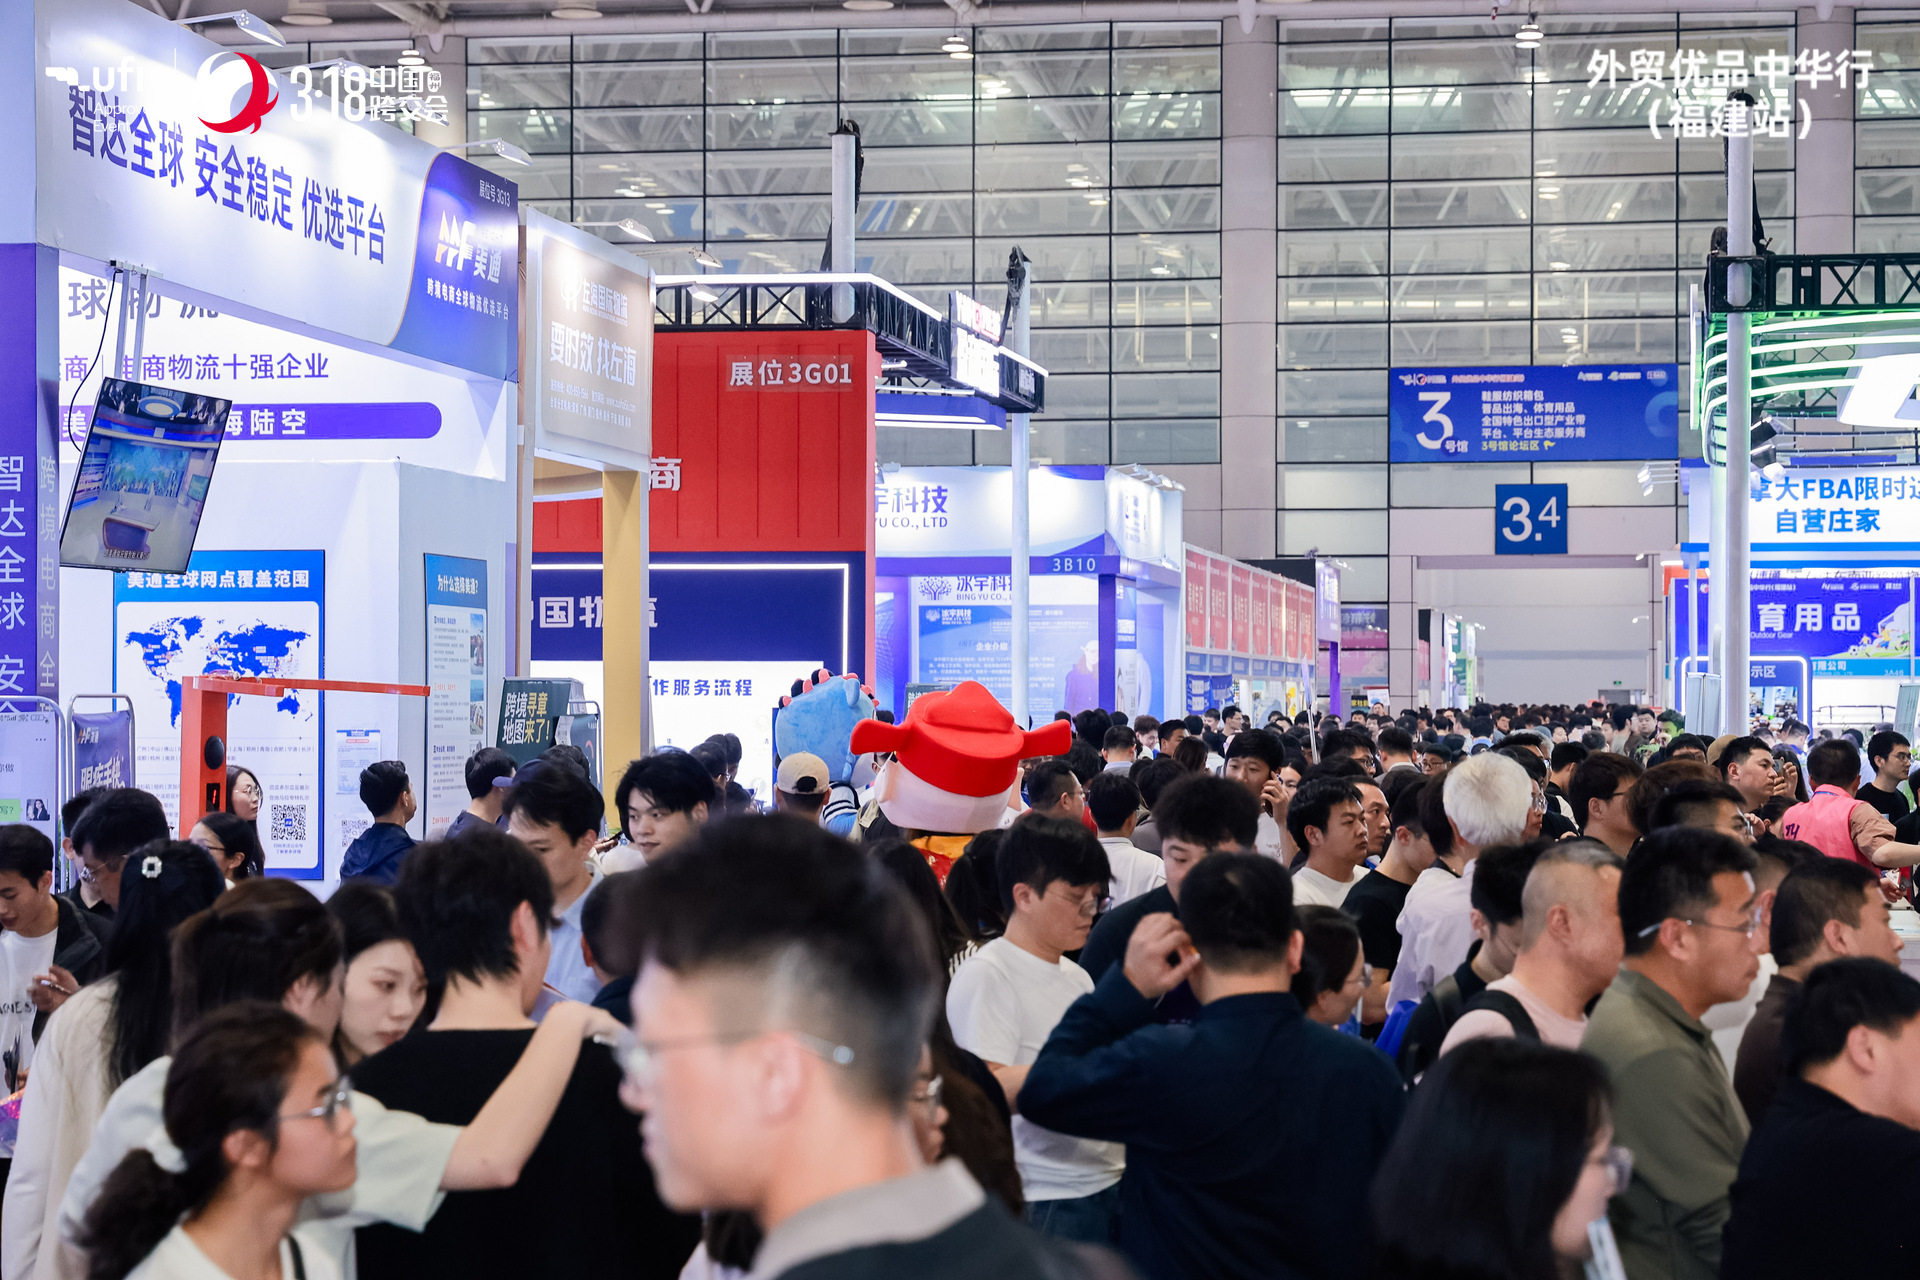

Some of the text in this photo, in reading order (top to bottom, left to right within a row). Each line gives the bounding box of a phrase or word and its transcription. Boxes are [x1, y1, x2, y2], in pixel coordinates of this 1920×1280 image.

[68, 84, 386, 265] 智达全球 安全稳定 优选平台
[550, 320, 637, 387] 要时效 找左海
[1481, 390, 1544, 402] 鞋服纺织箱包
[1416, 391, 1454, 450] 3
[1481, 414, 1586, 427] 全国特色出口型产业带
[1481, 427, 1586, 440] 平台、平台生态服务商
[1481, 440, 1540, 452] 3号馆论坛区
[922, 516, 949, 528] LTD
[1502, 496, 1561, 543] 3.4
[1776, 507, 1881, 534] 自营庄家
[1052, 557, 1097, 573] 3B10
[39, 455, 56, 712] 跨境电商全
[126, 570, 310, 589] 美通全球网点覆盖范围
[504, 691, 548, 718] 跨境寻章
